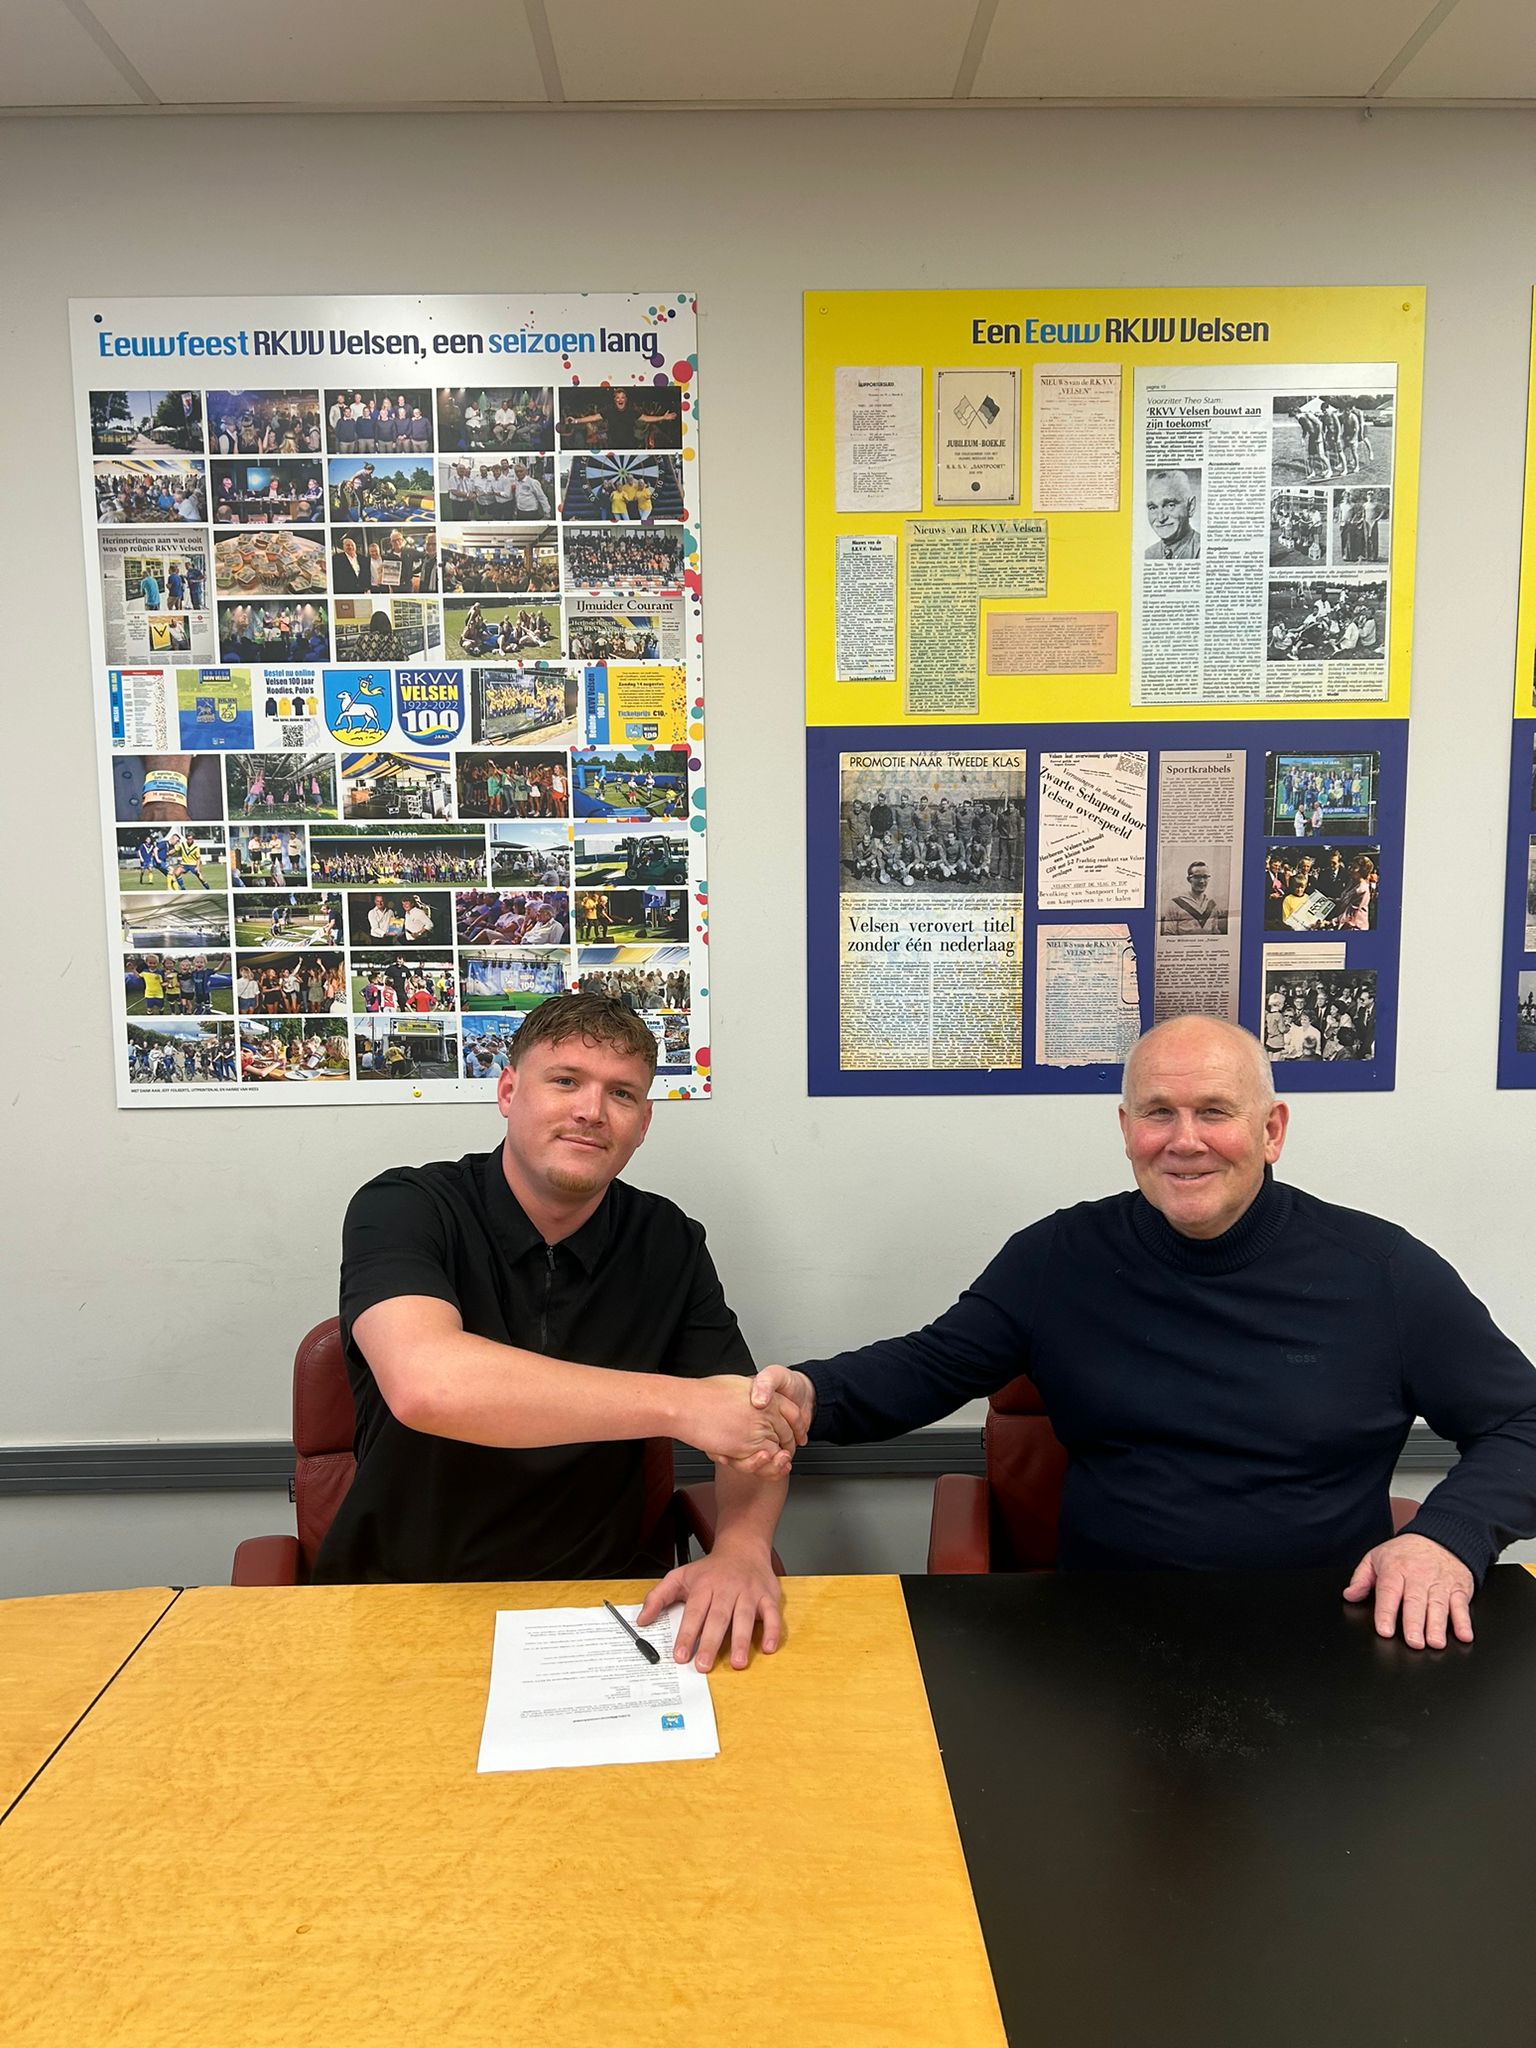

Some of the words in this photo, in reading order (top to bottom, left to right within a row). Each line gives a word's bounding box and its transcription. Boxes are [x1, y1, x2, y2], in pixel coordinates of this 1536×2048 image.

[972, 319, 1020, 344] Een
[1025, 319, 1100, 344] Eeuw
[1105, 318, 1176, 344] RKVV
[1179, 317, 1270, 342] Velsen
[99, 331, 249, 357] Eeuwfeest
[253, 330, 324, 356] RKVV
[329, 329, 427, 358] Velsen,
[433, 334, 483, 354] een
[488, 328, 595, 353] seizoen
[600, 327, 658, 360] lang
[1180, 406, 1210, 415] Velsen
[1212, 406, 1242, 415] bouwt
[1146, 419, 1163, 429] zijn
[914, 525, 946, 535] Nieuws
[1014, 523, 1042, 533] Velsen
[576, 600, 624, 613] IJmuider
[627, 600, 673, 610] Courant
[301, 678, 314, 686] jaar
[400, 672, 458, 684] RKVV
[266, 686, 294, 695] Hoodies,
[295, 686, 314, 694] Polo's
[401, 685, 458, 701] VELSEN
[402, 710, 459, 732] 100
[850, 757, 906, 768] PROMOTIE
[910, 757, 942, 767] NAAR
[948, 757, 988, 768] TWEEDE
[992, 756, 1020, 767] KLAS
[1167, 765, 1231, 775] Sportkrabbels
[1039, 766, 1074, 793] Zwarte
[1076, 787, 1120, 813] Schapen
[1122, 812, 1147, 831] door
[1042, 783, 1074, 810] Velsen
[1076, 806, 1132, 840] overspeeld
[1064, 842, 1082, 852] Velsen
[849, 916, 899, 932] Velsen
[909, 919, 974, 932] verovert
[984, 916, 1015, 932] titel
[848, 936, 901, 952] zonder
[906, 938, 932, 951] één
[940, 936, 1015, 957] nederlaag
